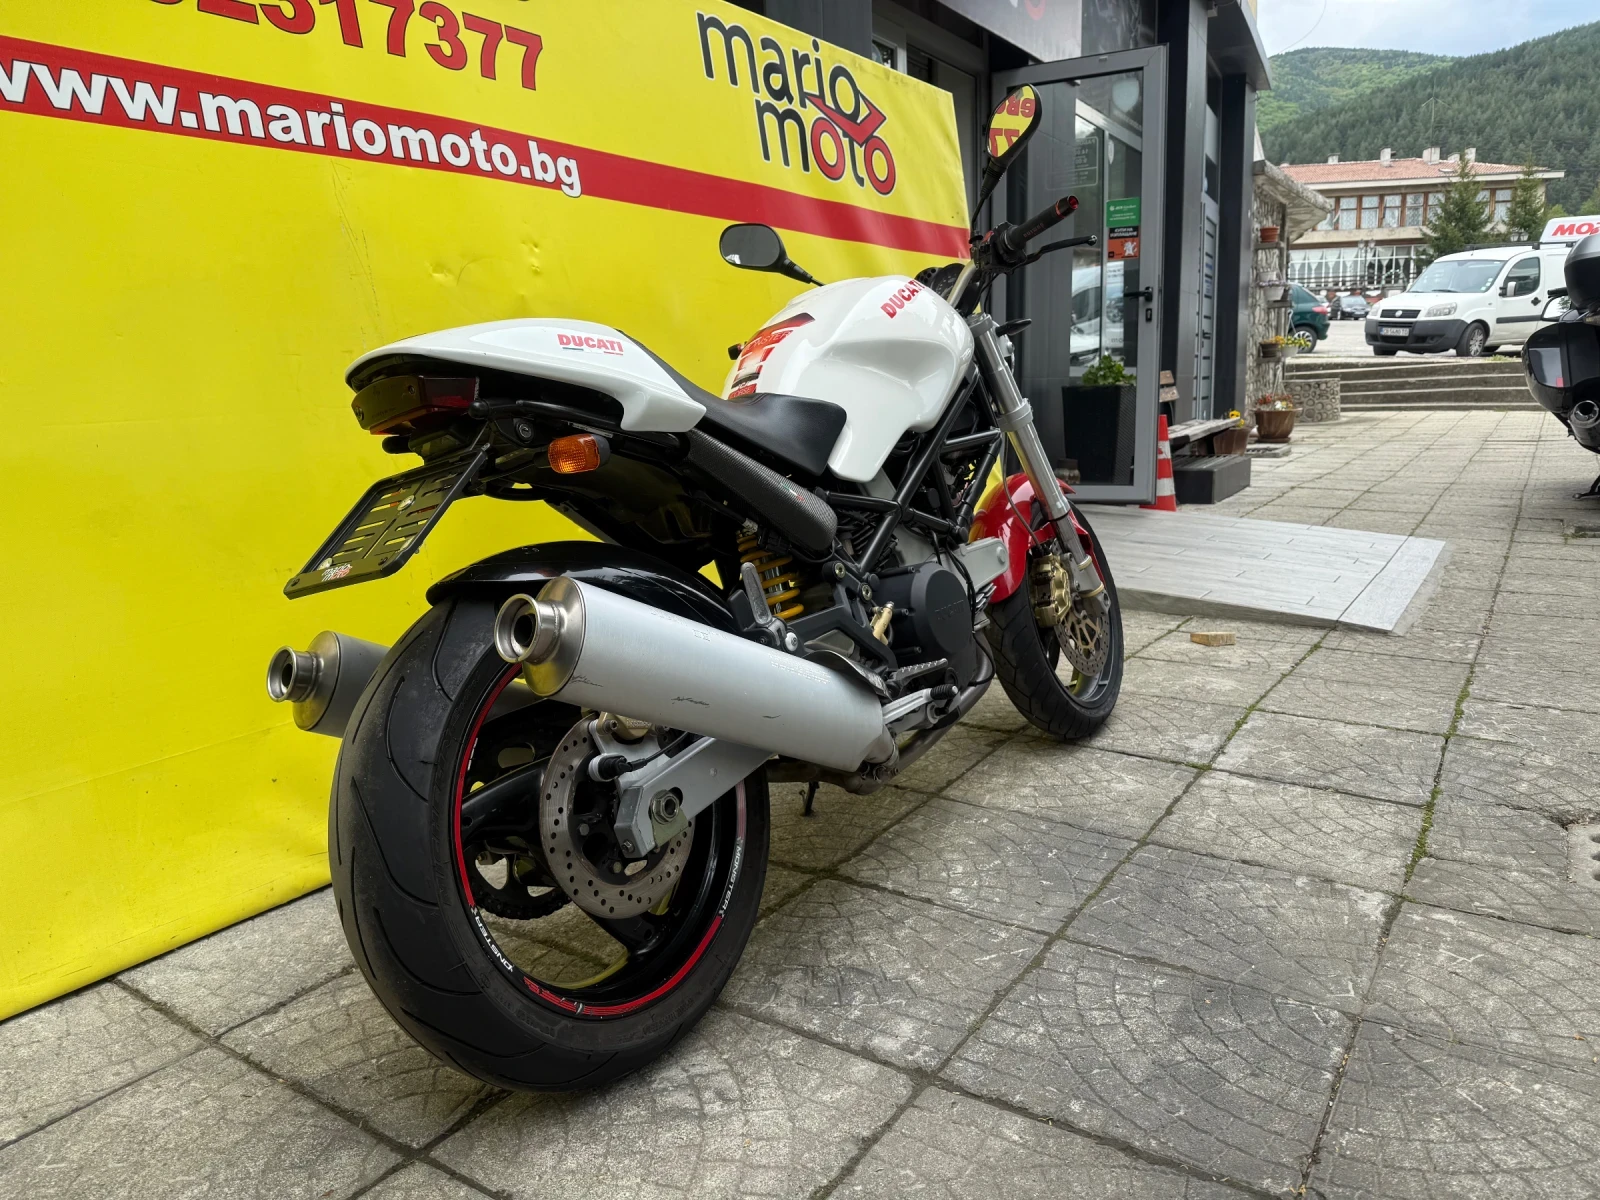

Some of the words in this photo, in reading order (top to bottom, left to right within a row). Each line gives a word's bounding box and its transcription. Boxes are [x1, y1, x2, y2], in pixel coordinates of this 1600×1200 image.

[696, 11, 862, 125] mario
[755, 97, 897, 196] moto
[1552, 222, 1600, 236] MO
[880, 279, 926, 319] DUCATI
[557, 333, 624, 353] DUCATI
[722, 846, 742, 910] MONSTER
[475, 915, 515, 973] ONSTER
